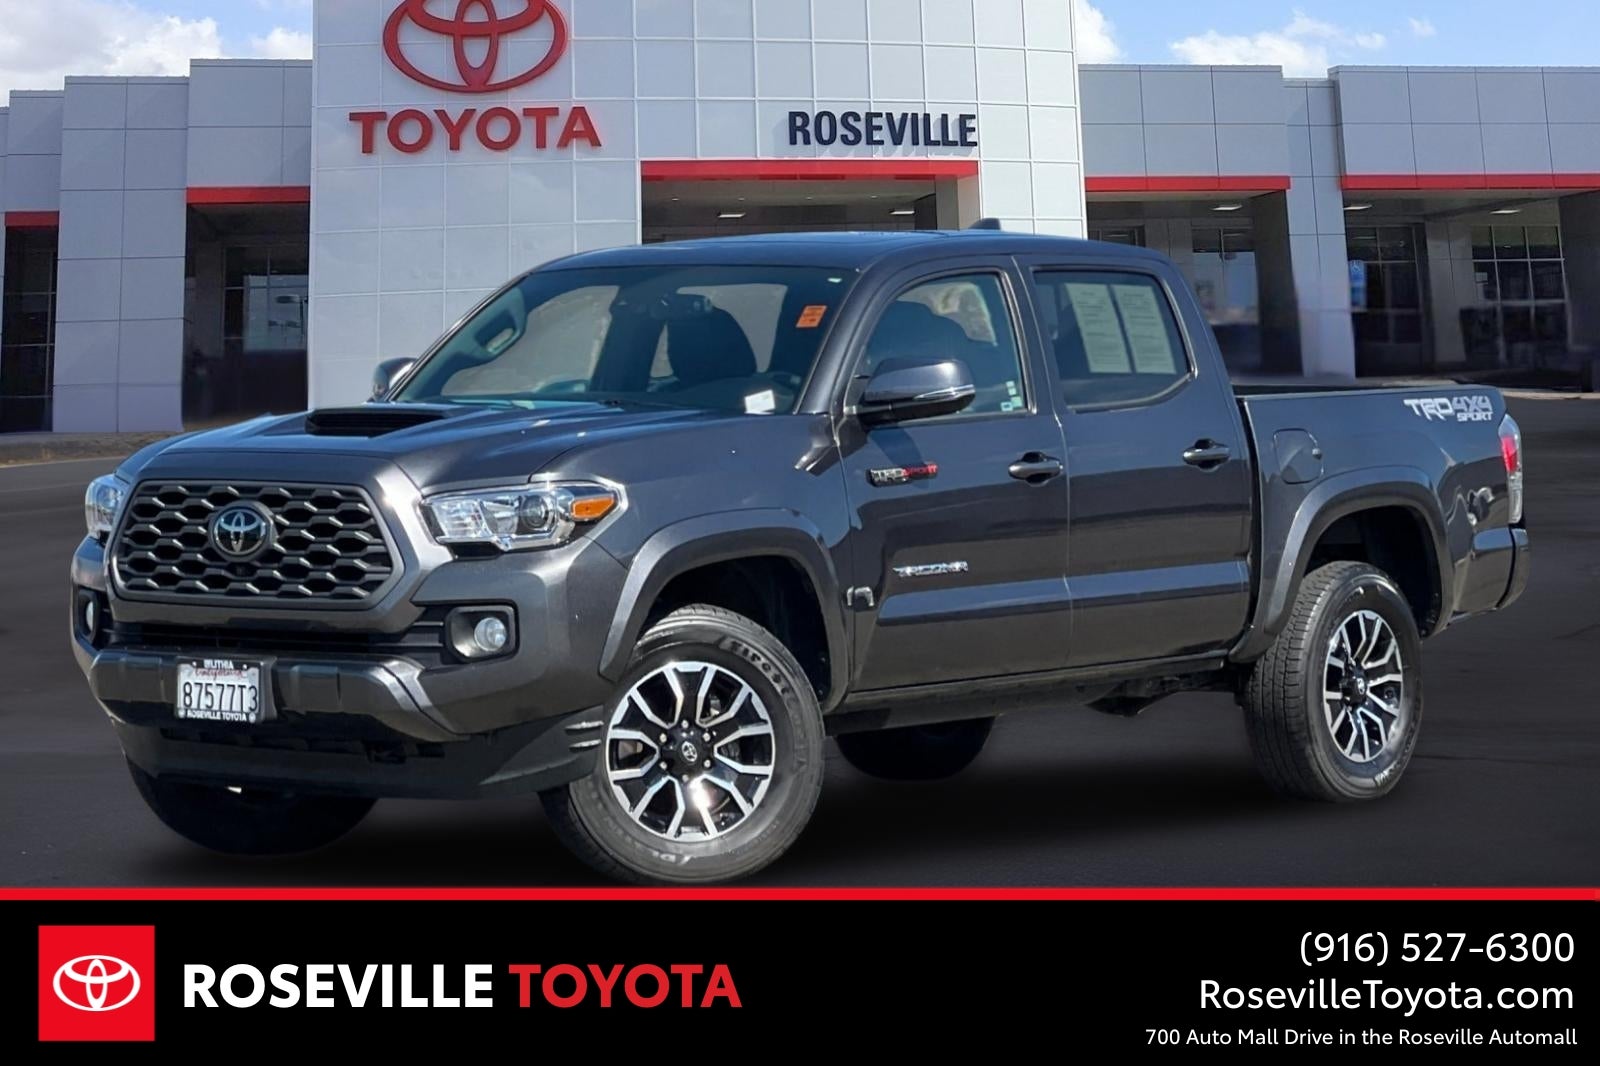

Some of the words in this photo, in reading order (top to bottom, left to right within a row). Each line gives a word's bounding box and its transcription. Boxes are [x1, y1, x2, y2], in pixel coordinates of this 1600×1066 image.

[349, 106, 602, 154] TOYOTA
[788, 110, 978, 147] ROSEVILLE
[1403, 397, 1455, 420] TRD
[1457, 411, 1493, 422] SPORT
[183, 681, 258, 712] 87577T3
[221, 711, 247, 722] TOYOTA
